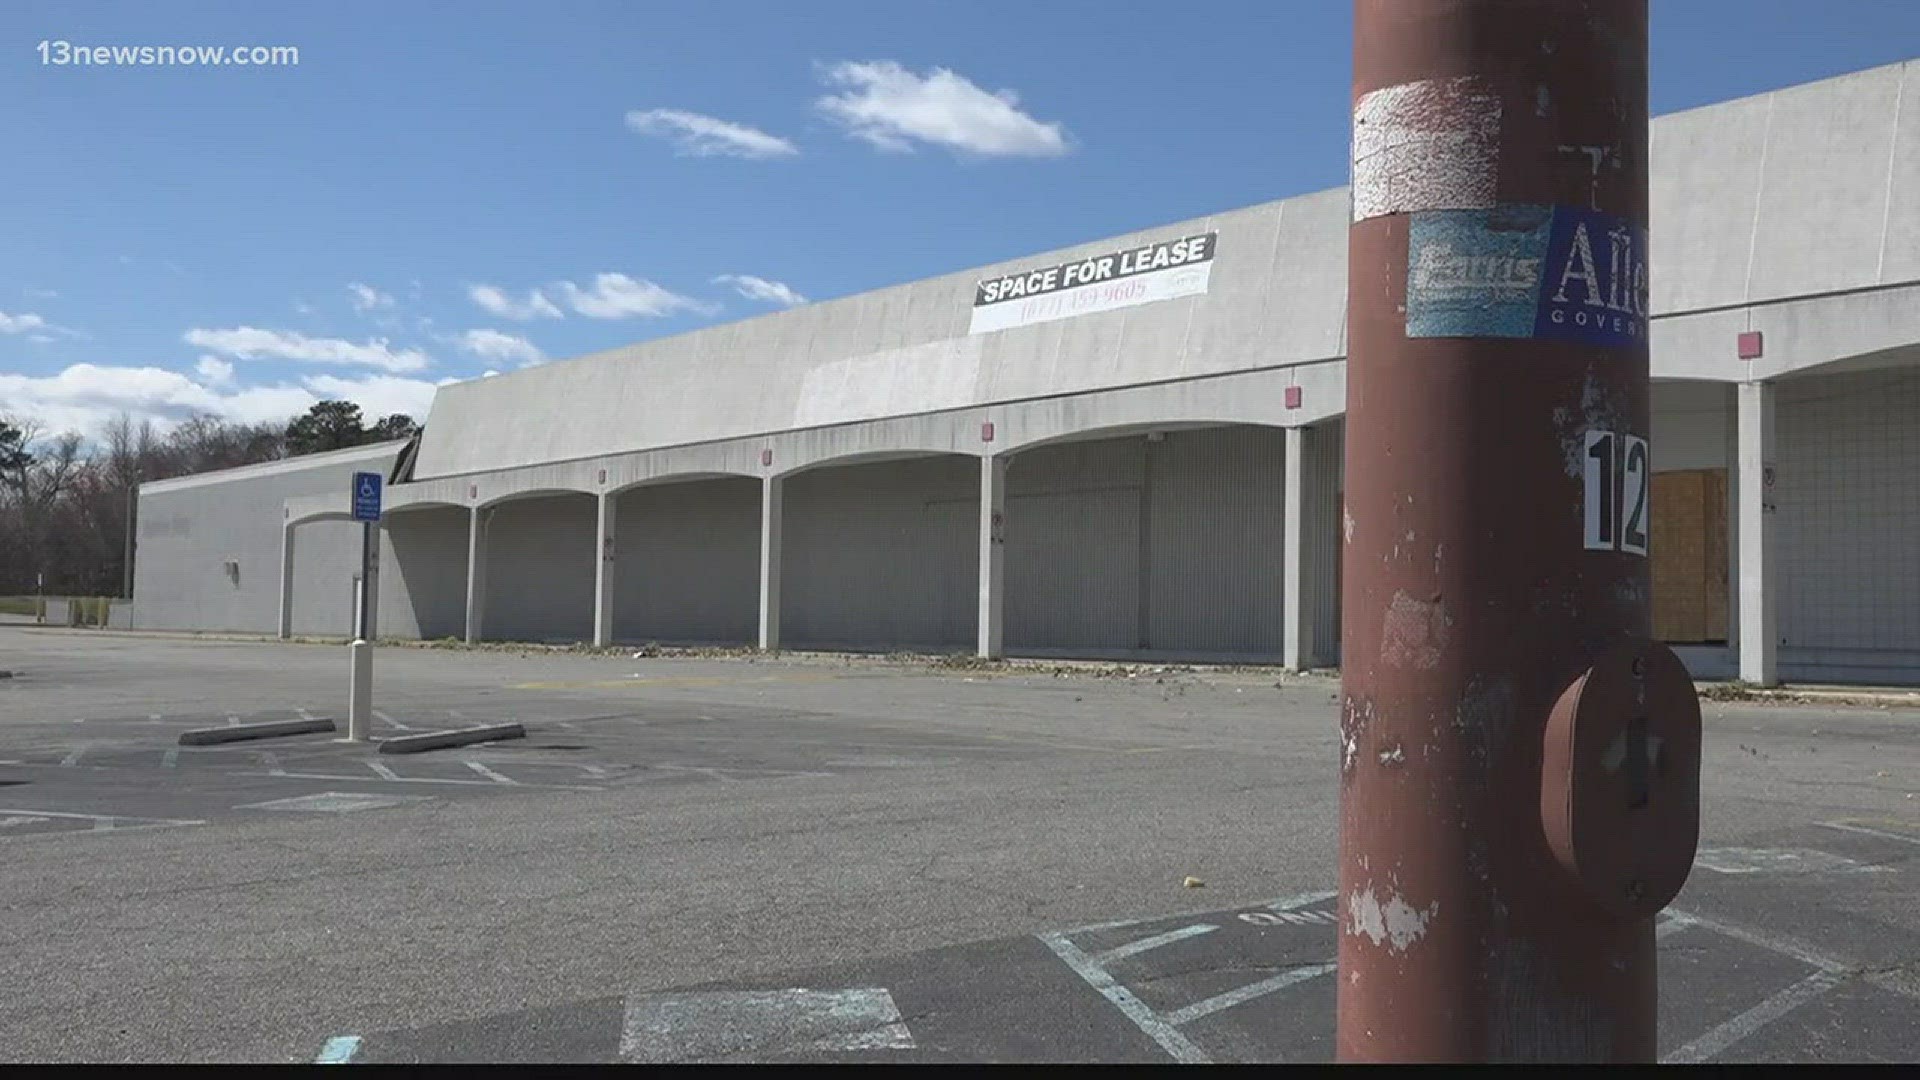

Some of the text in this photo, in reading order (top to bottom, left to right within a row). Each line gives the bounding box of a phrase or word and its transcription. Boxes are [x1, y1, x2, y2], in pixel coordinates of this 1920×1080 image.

[984, 238, 1205, 302] SPACE FOR LEASE
[1552, 222, 1648, 316] Alle
[1589, 435, 1646, 548] 12
